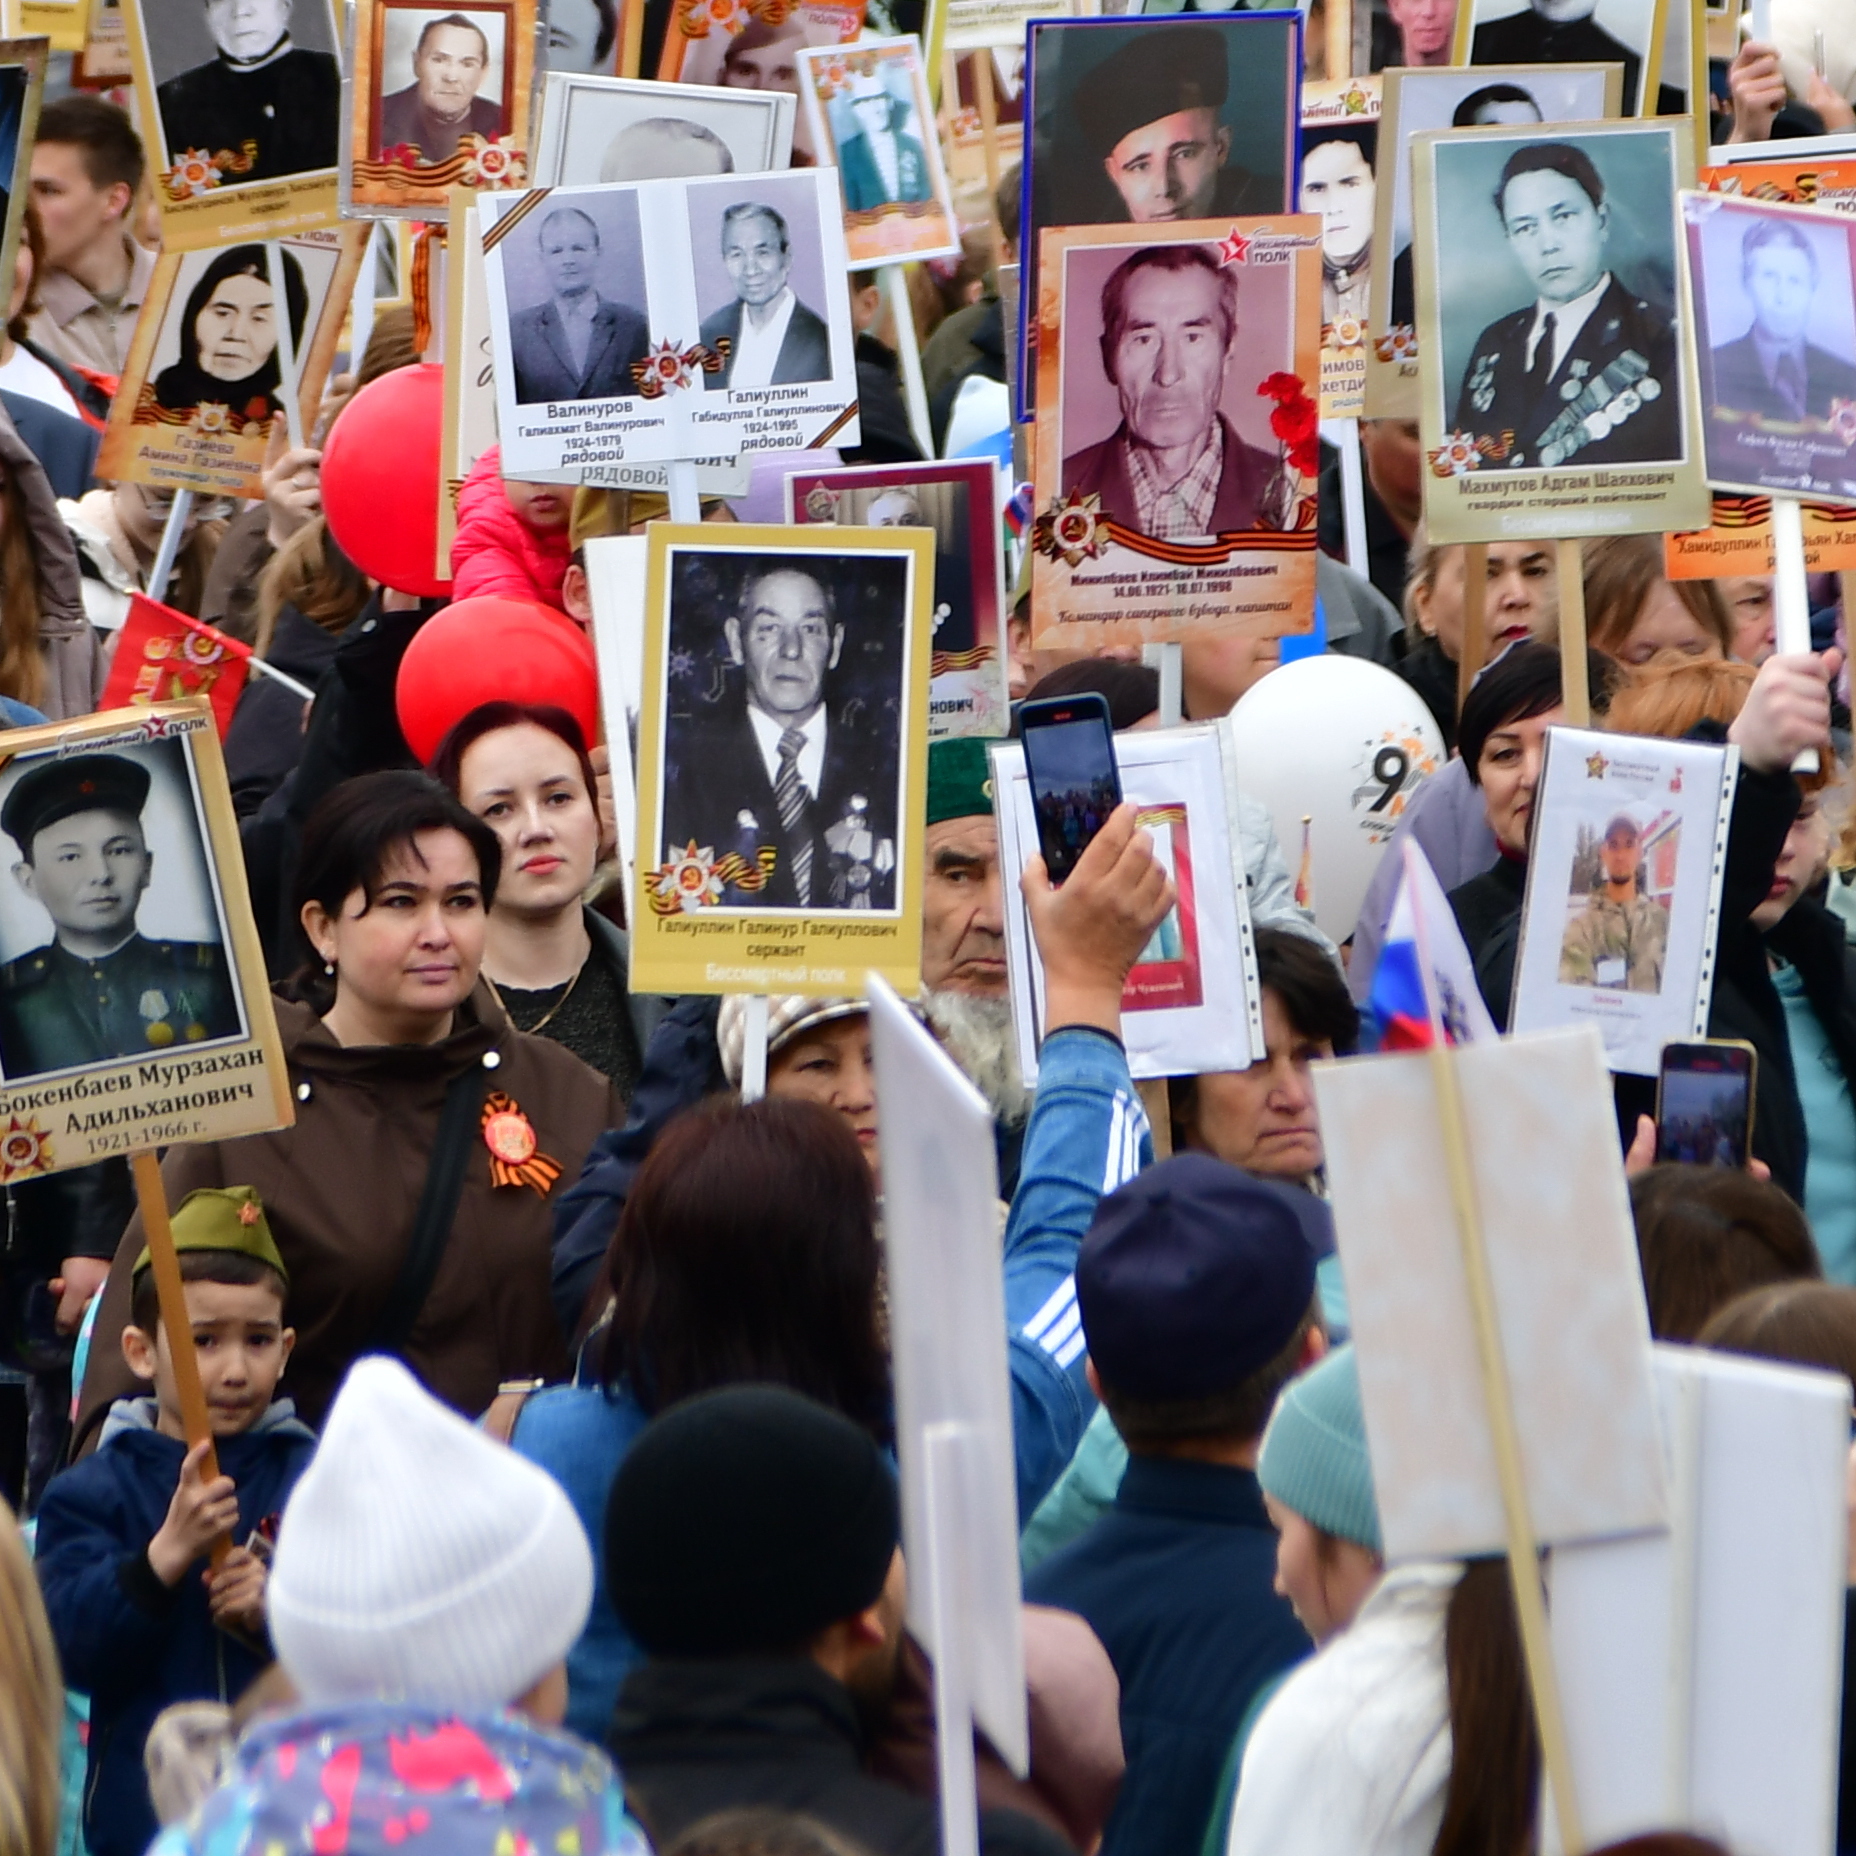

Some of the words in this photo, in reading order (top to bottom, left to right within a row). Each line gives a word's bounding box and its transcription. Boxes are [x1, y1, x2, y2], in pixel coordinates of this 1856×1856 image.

[1254, 249, 1290, 262] ПОЛК
[726, 386, 810, 405] Галиуллин
[546, 402, 634, 420] Валинуров
[691, 406, 754, 424] Габидулла
[755, 401, 847, 419] Галиуллинович
[517, 422, 582, 439] Галиахмат
[584, 417, 666, 435] Валинурович
[742, 419, 800, 435] 1924-1995
[175, 434, 236, 456] Газиева
[564, 434, 623, 450] 1924-1979
[739, 433, 804, 453] рядовой
[138, 446, 189, 466] Амина
[191, 451, 262, 475] Газиевна
[560, 446, 625, 468] рядовой
[1458, 475, 1537, 498] Махмутов
[1540, 474, 1590, 494] Адгам
[1594, 471, 1675, 492] Шаяхович
[1528, 493, 1589, 510] старший
[1234, 600, 1293, 618] капитан
[168, 714, 207, 736] ПОЛК
[1371, 745, 1408, 813] 9
[656, 918, 735, 939] Галиуллин
[737, 919, 799, 939] Галинур
[800, 920, 898, 940] Галиуллович
[745, 943, 806, 959] сержант
[705, 962, 807, 985] Бессмертный
[810, 967, 846, 983] полк
[138, 1048, 265, 1089] Мурзахан
[65, 1083, 255, 1133] Адильханович
[87, 1121, 190, 1155] 1921-1966
[194, 1119, 209, 1135] г.
